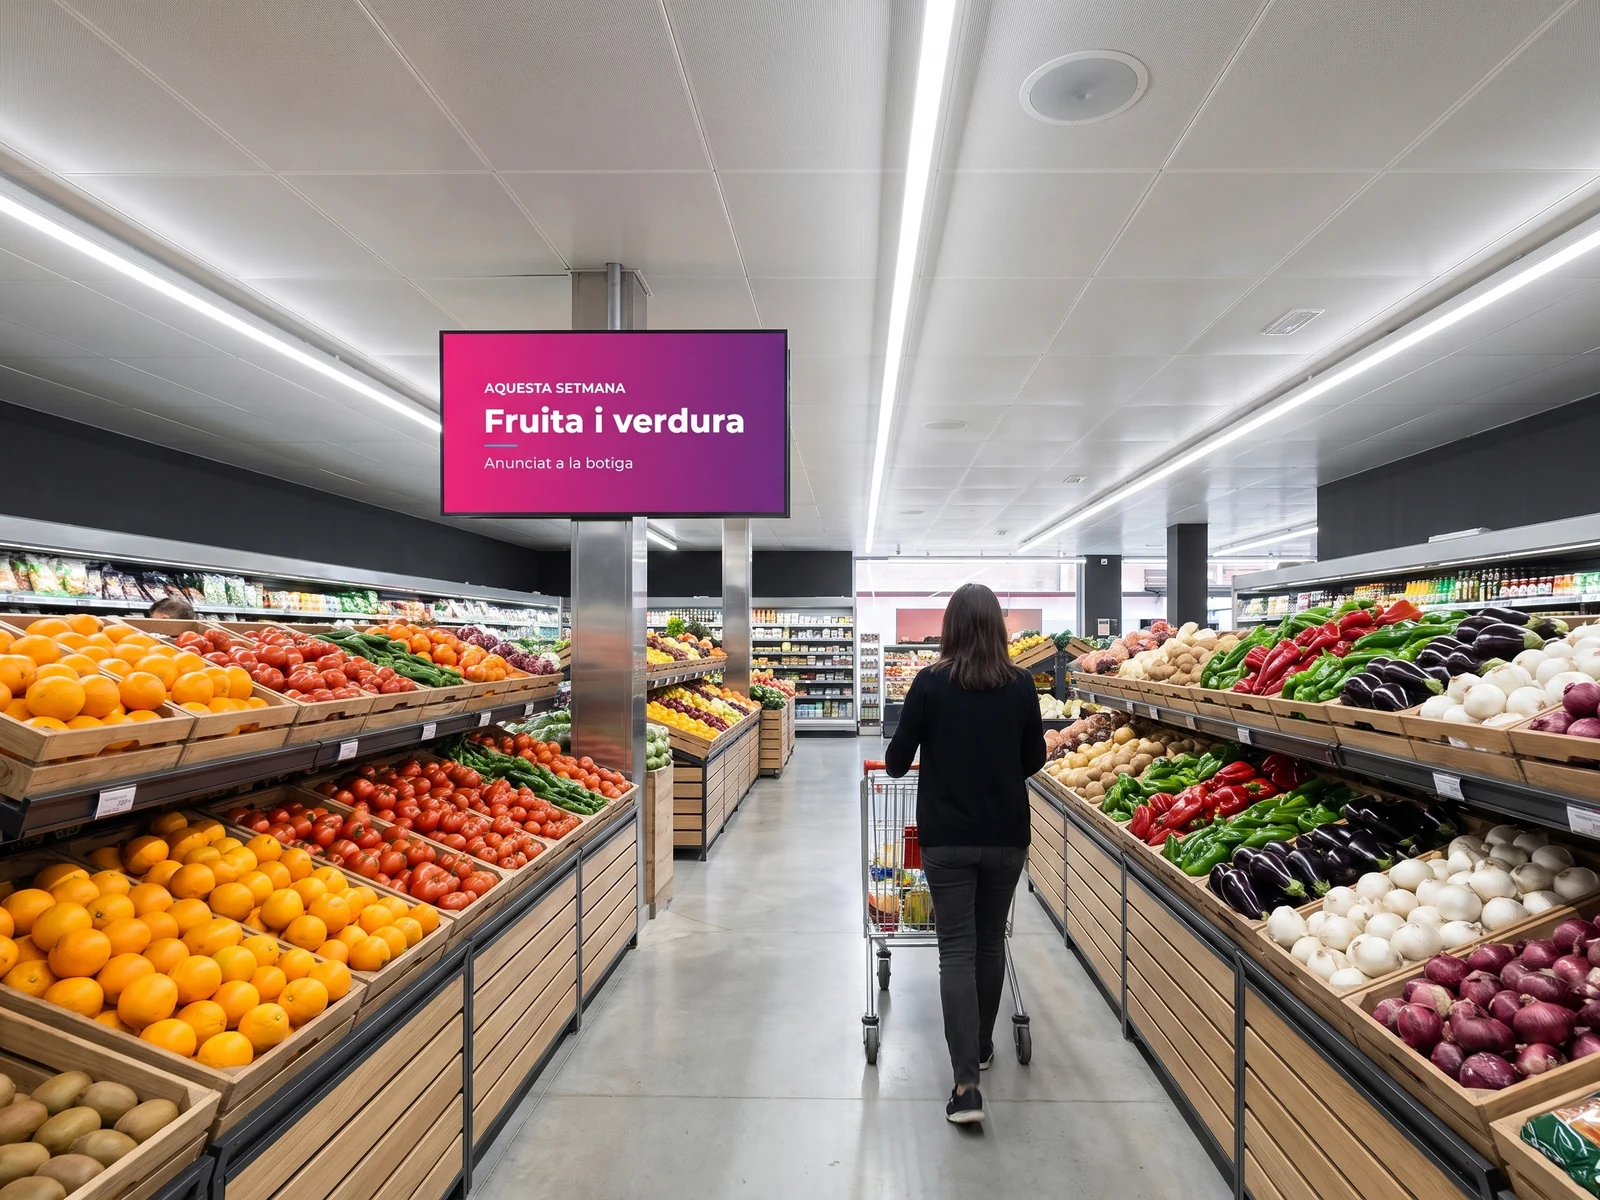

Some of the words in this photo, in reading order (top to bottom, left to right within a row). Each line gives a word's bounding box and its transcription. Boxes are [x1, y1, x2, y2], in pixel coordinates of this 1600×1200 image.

[484, 382, 552, 396] AQUESTA
[555, 382, 626, 394] SETMANA
[484, 405, 584, 434] Fruita
[594, 405, 604, 434] i
[612, 407, 745, 434] verdura
[484, 456, 552, 470] Anunciat
[555, 459, 564, 470] a
[569, 456, 581, 470] la
[585, 456, 633, 472] botiga
